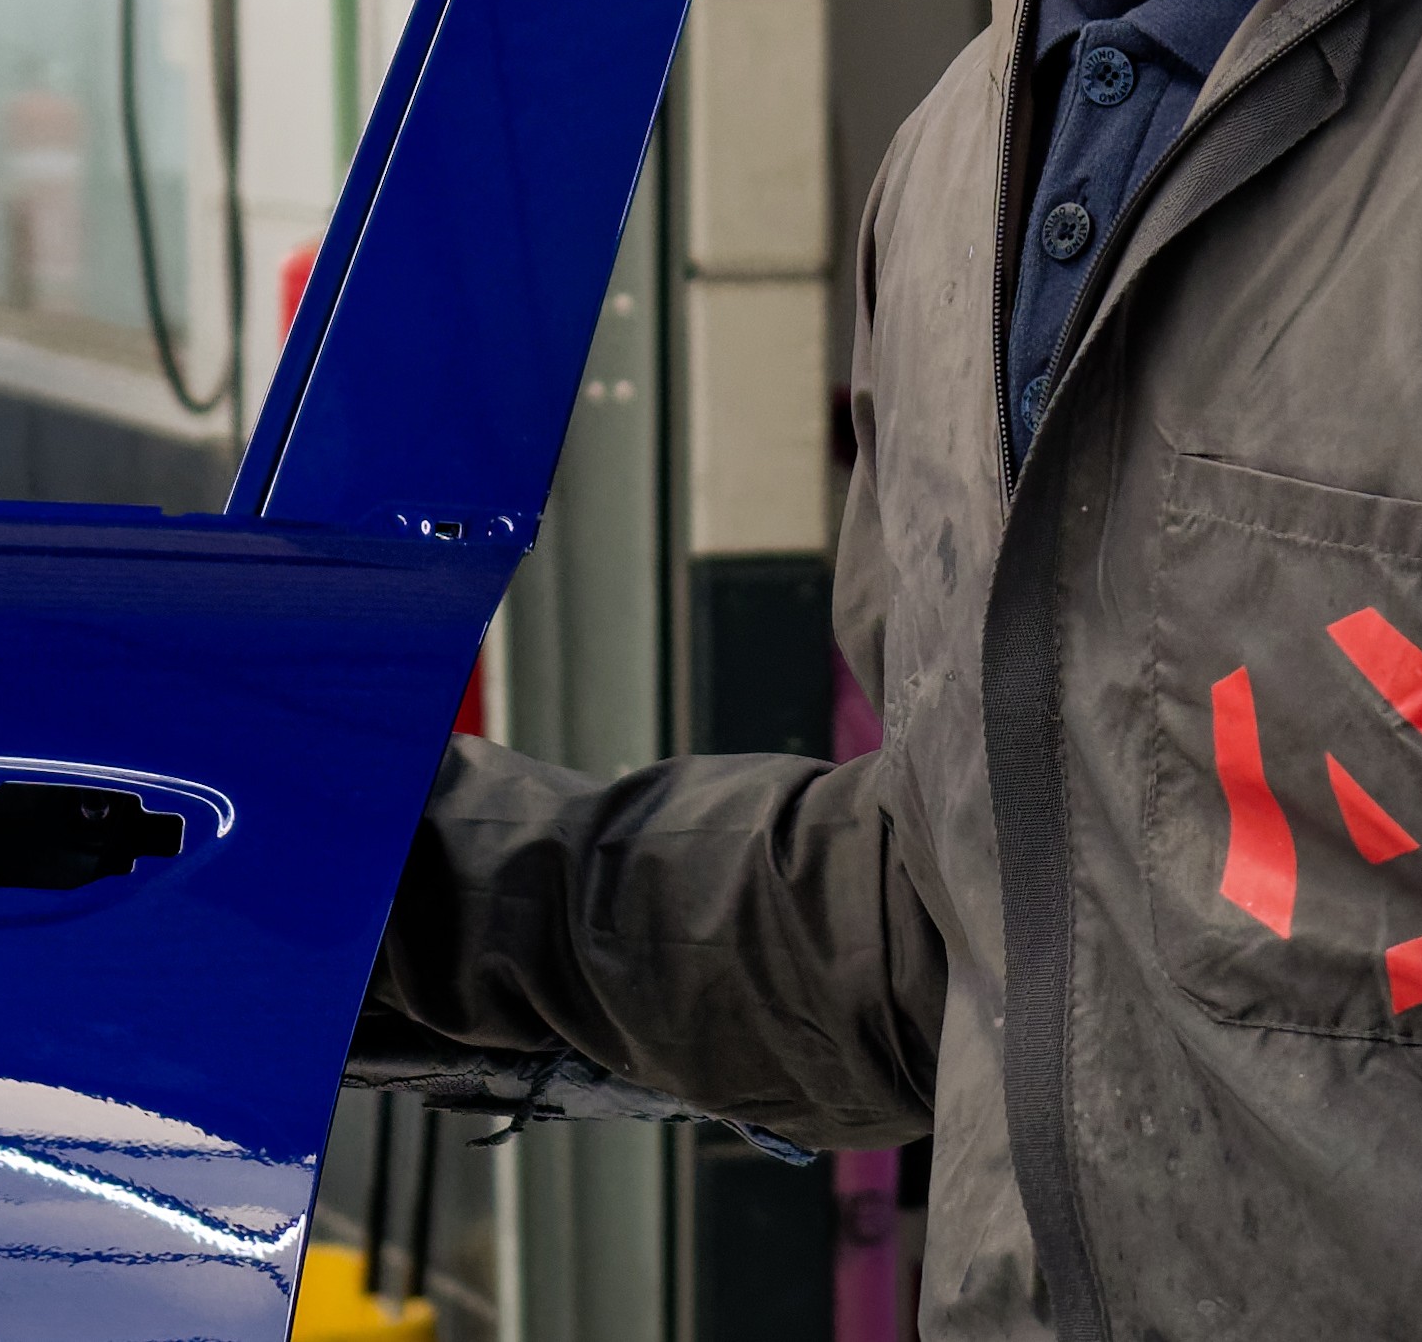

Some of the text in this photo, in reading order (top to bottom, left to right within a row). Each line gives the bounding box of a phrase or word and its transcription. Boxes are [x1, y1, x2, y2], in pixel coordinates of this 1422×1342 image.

[1083, 49, 1115, 93] SANTINO
[1099, 60, 1132, 103] SANTINO
[1044, 207, 1066, 255] SANTINO
[1065, 206, 1087, 255] SANTINO
